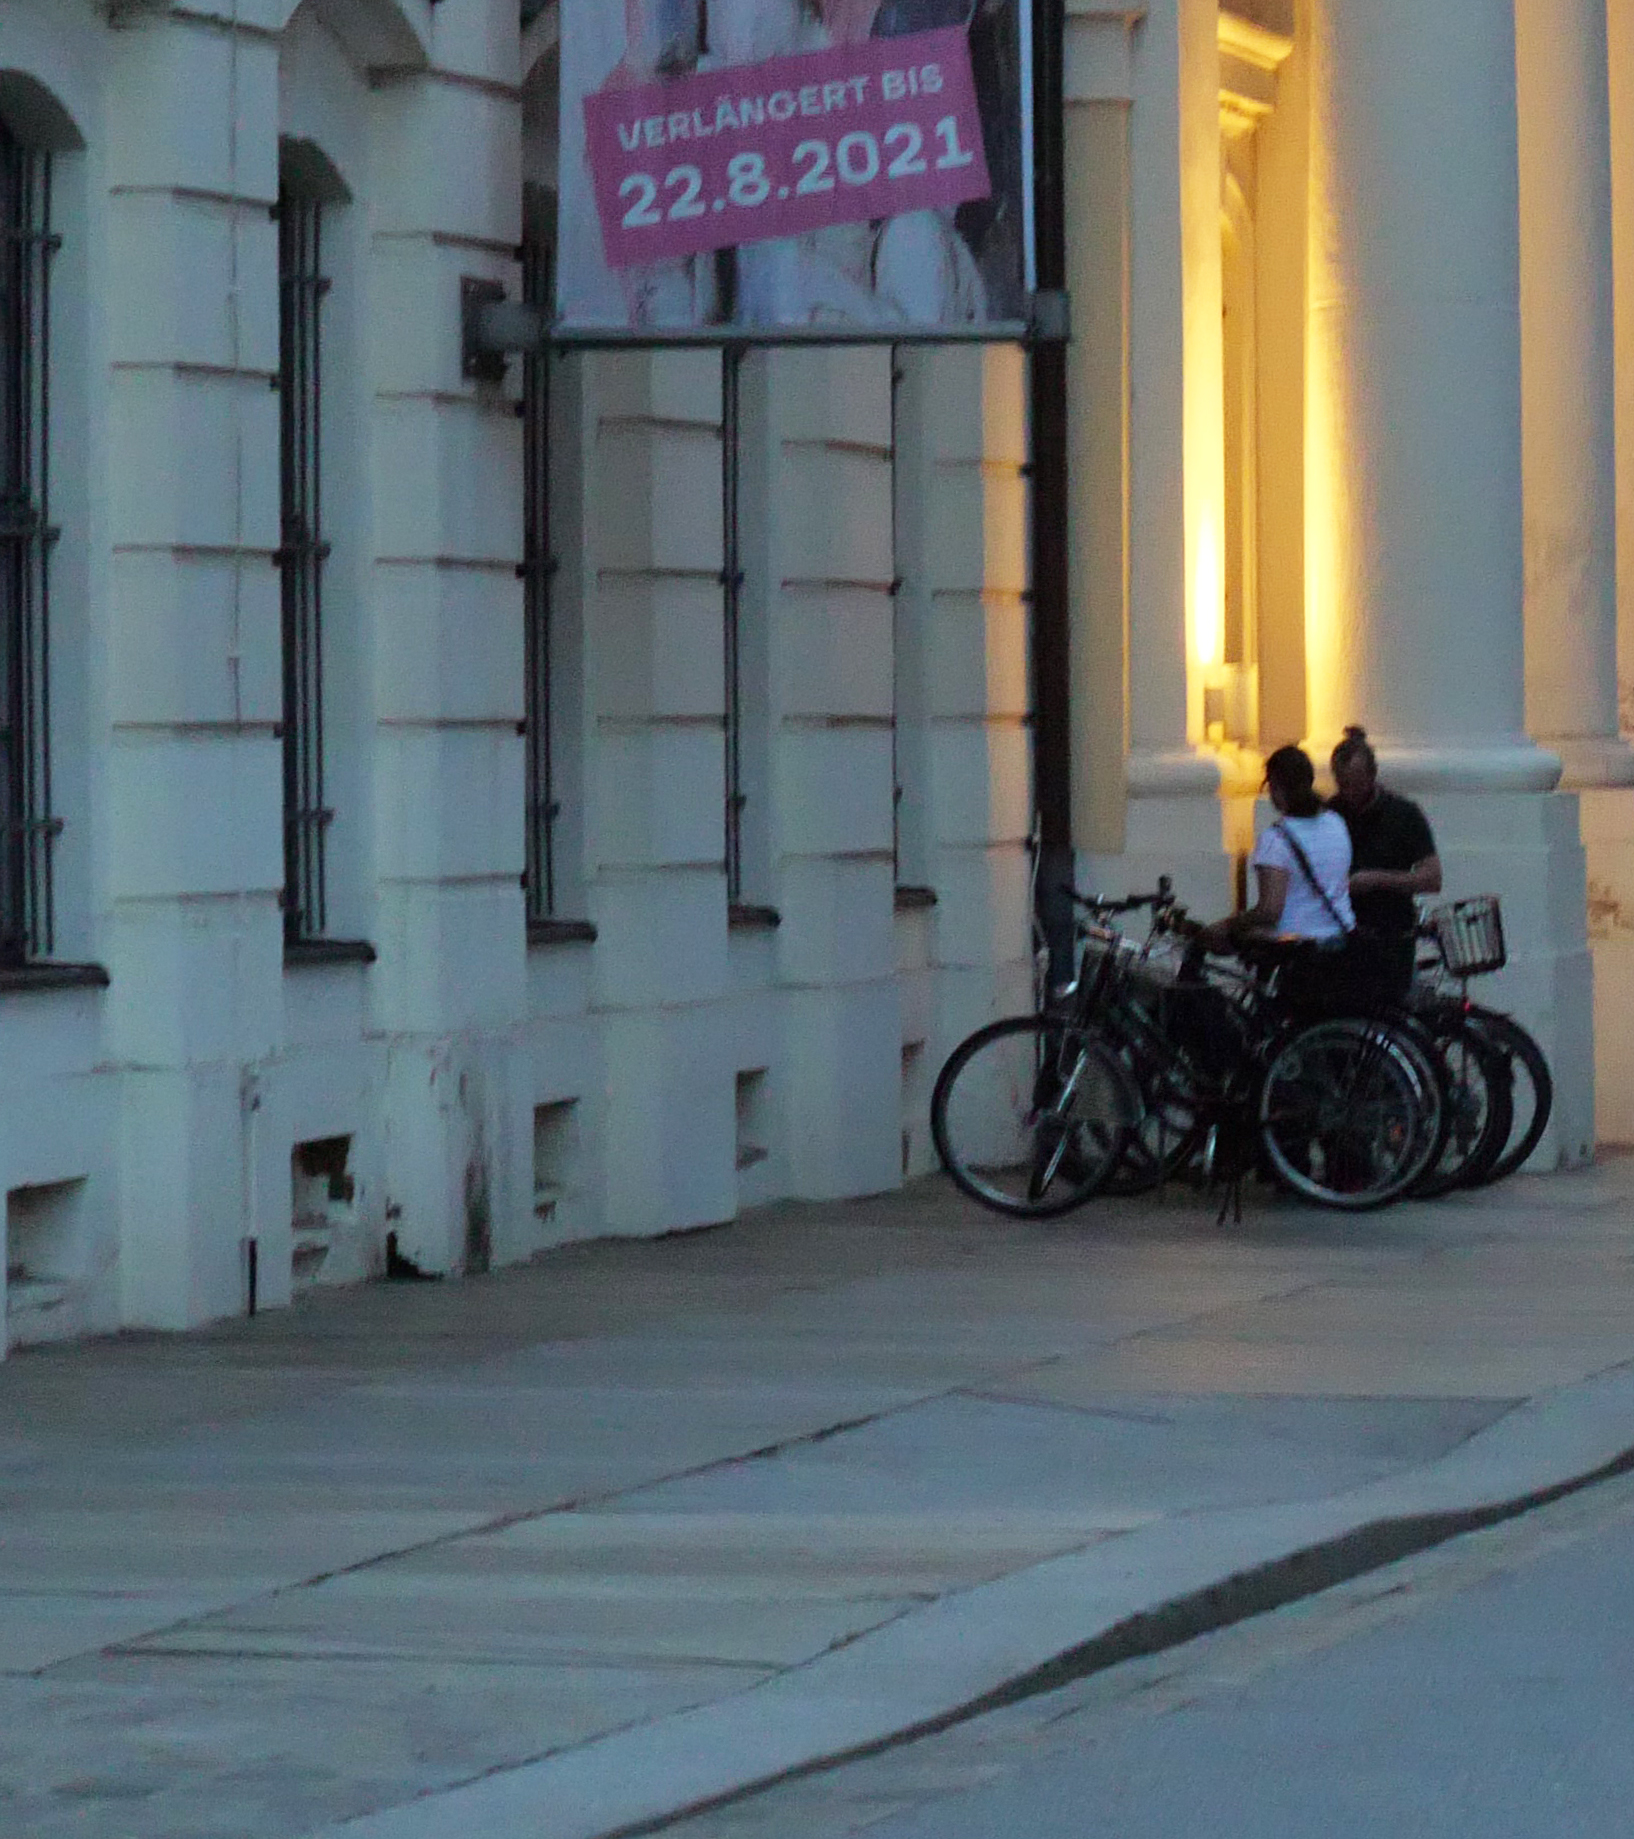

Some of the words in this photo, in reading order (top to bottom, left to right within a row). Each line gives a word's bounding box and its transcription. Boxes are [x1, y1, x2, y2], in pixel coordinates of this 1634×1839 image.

[617, 75, 870, 152] VERLÄNGERT
[881, 63, 944, 101] BIS
[617, 114, 975, 231] 22.8.2021
